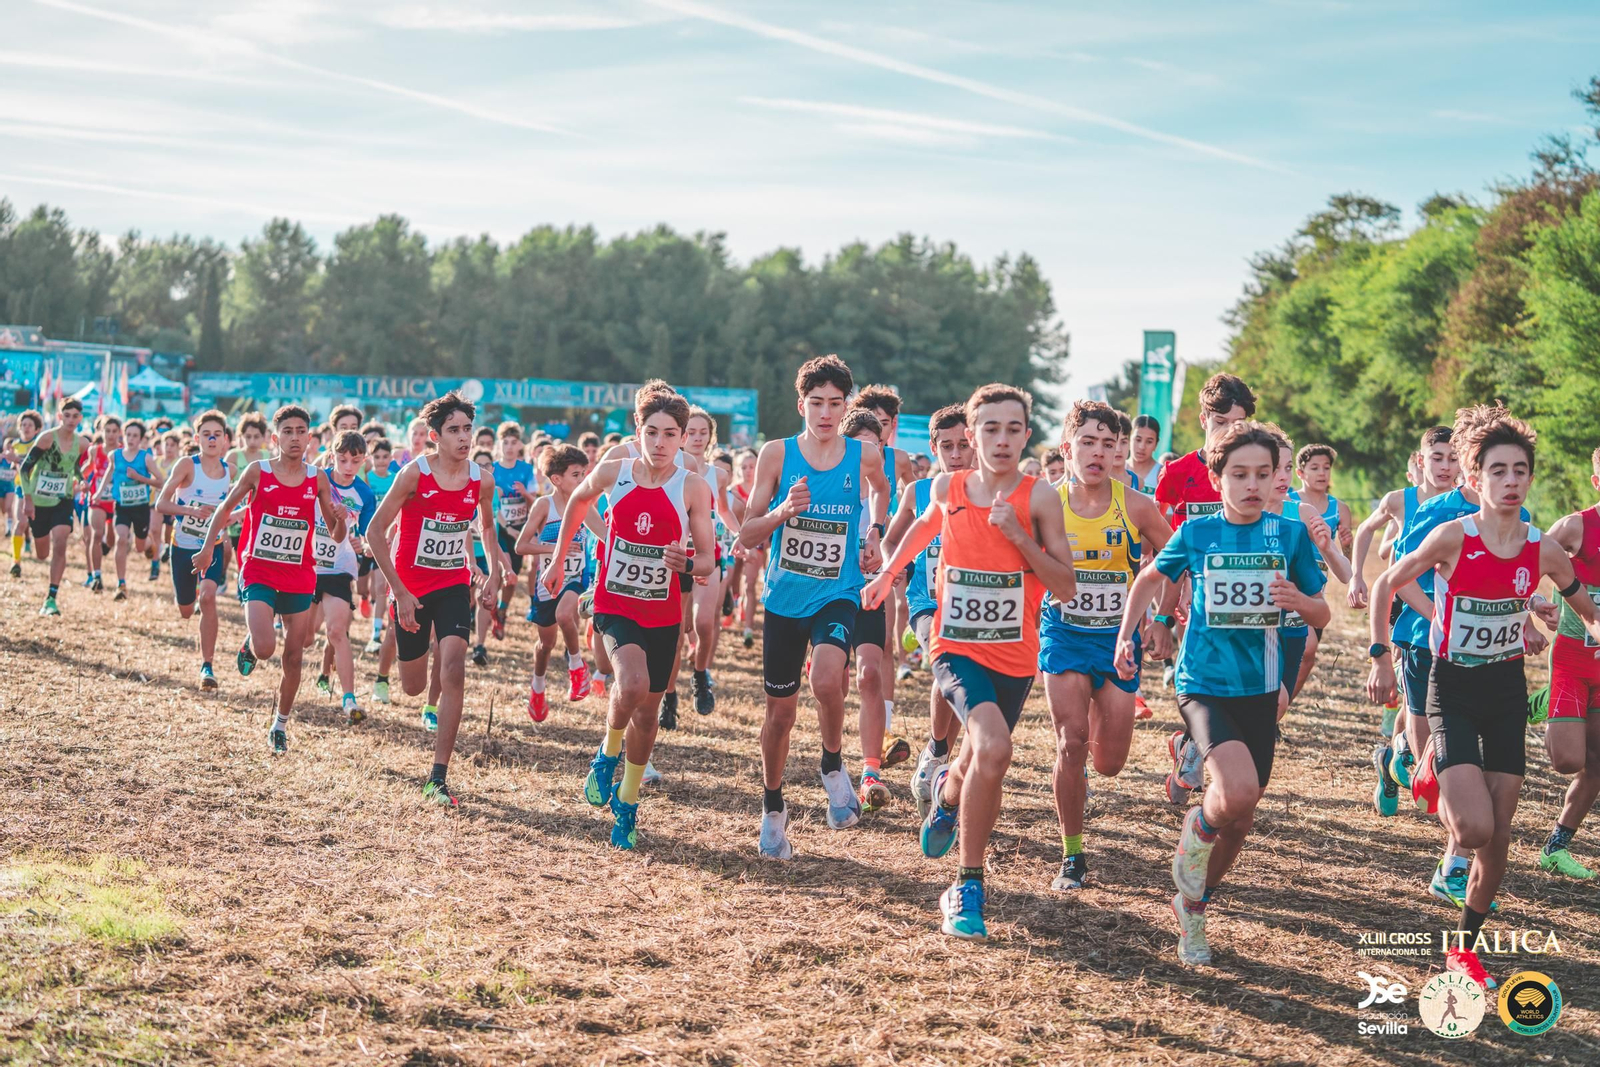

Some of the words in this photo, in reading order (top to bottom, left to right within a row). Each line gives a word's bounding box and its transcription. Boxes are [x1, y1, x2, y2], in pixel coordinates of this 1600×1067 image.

[40, 480, 65, 492] 7987
[122, 487, 146, 499] 8038
[806, 503, 854, 515] TASIERR
[260, 532, 303, 551] 8010
[423, 538, 464, 556] 8012
[785, 537, 841, 563] 8033
[544, 557, 582, 572] 817
[1228, 555, 1268, 566] ITÁLICA
[615, 559, 668, 585] 7953
[964, 572, 1003, 584] ITÁLICA
[1079, 571, 1111, 581] ITÁLICA
[949, 596, 1018, 622] 5882
[1459, 621, 1521, 650] 7948
